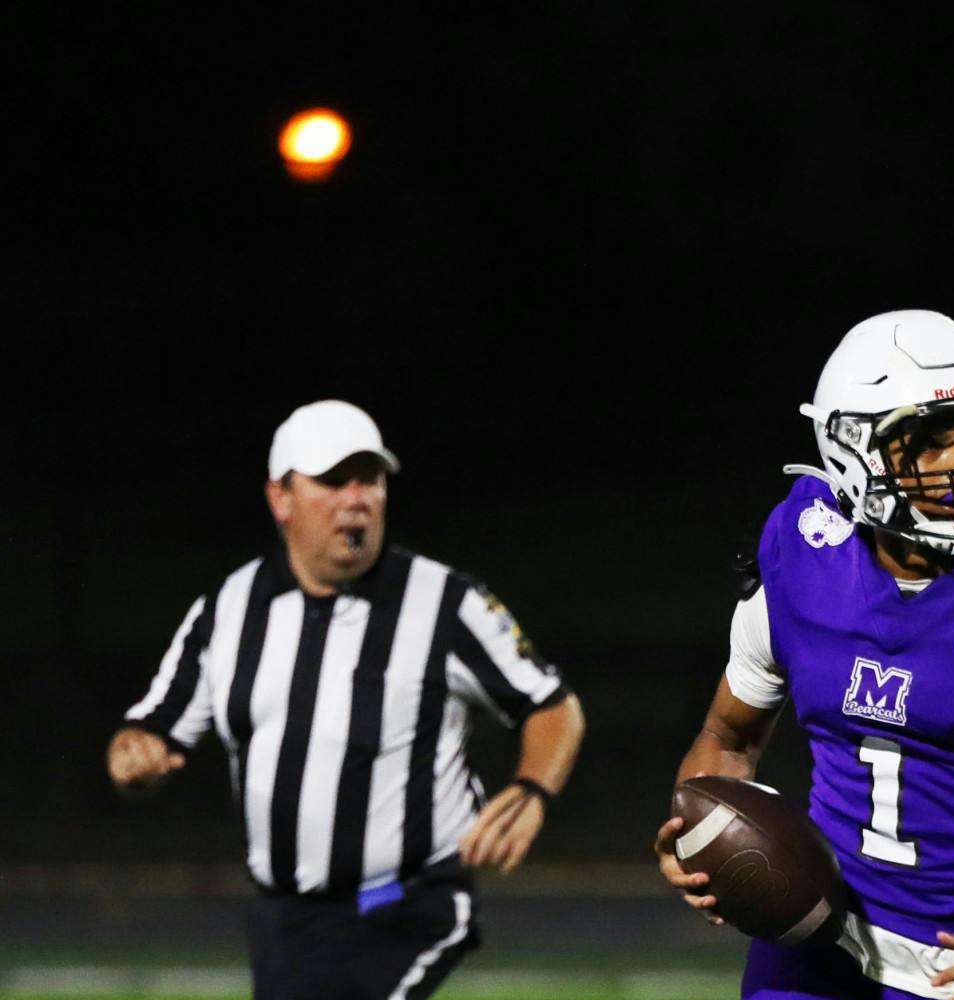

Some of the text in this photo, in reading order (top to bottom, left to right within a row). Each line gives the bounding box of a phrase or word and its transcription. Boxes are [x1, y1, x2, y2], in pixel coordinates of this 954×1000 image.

[844, 656, 912, 712] M
[845, 701, 904, 721] Bearcats
[859, 735, 917, 866] 1
